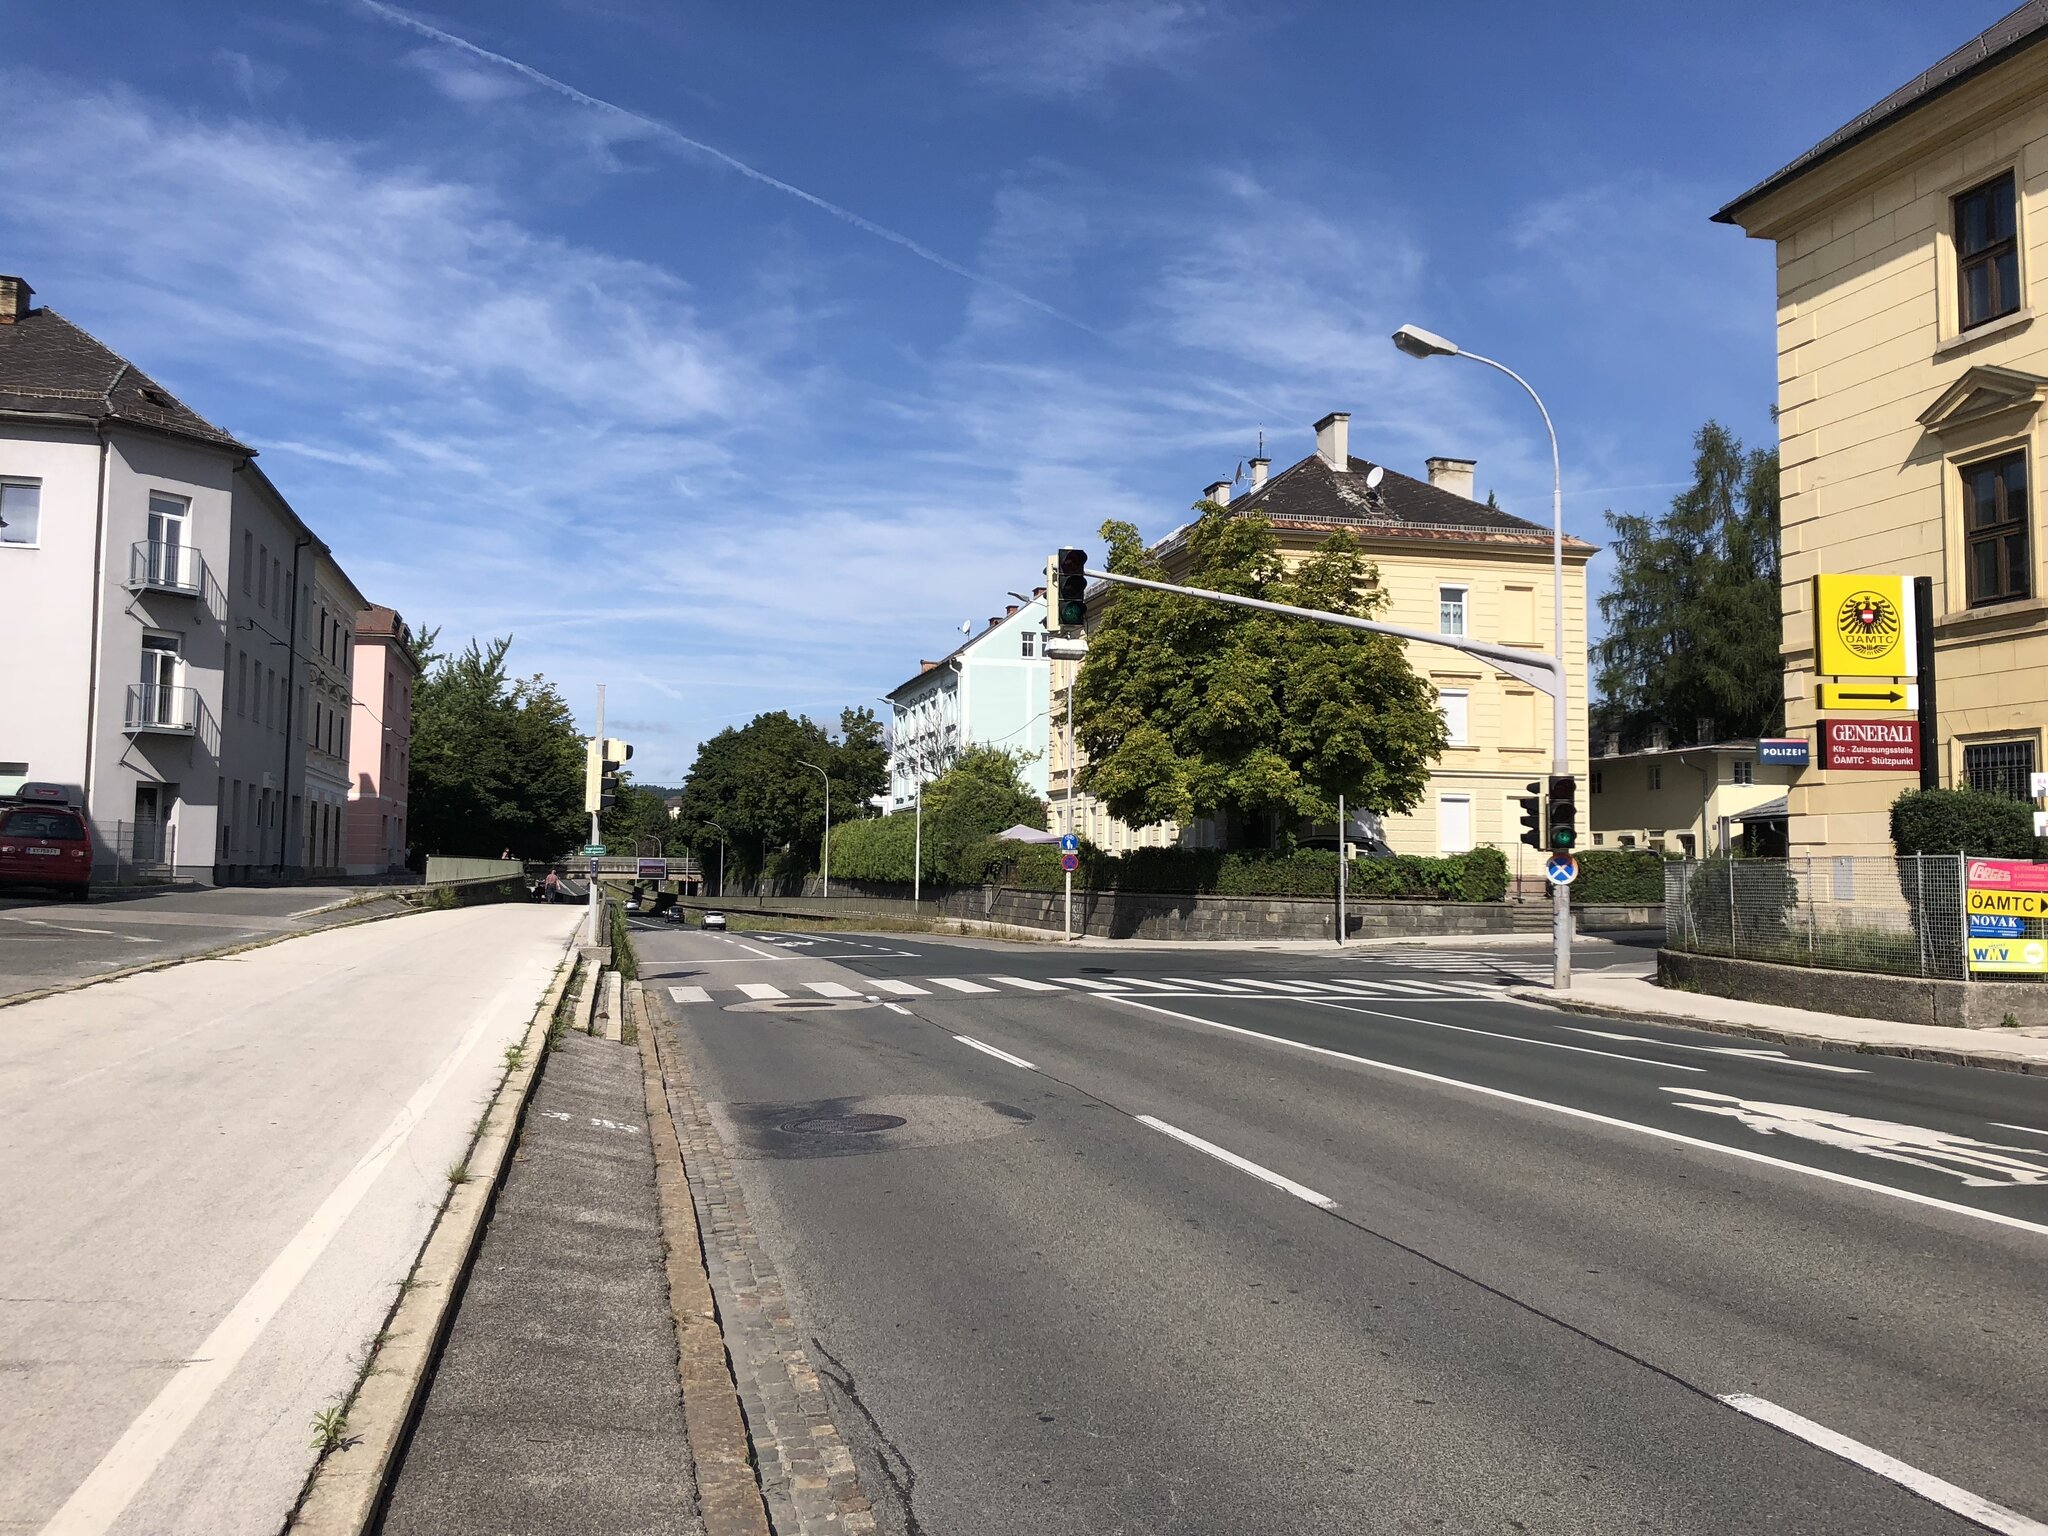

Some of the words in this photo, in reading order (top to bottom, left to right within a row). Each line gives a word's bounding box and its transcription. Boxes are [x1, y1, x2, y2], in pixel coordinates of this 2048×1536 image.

[1832, 724, 1913, 742] GENERALI
[1763, 748, 1802, 756] POLIZEI
[1833, 745, 1846, 753] Kfz
[1851, 745, 1914, 755] Zulassungsstelle
[1833, 754, 1865, 765] ÖAMTC
[1871, 756, 1914, 767] Stützpunkt
[1971, 891, 2034, 912] ÖAMTC
[1971, 915, 2018, 928] NOVAK
